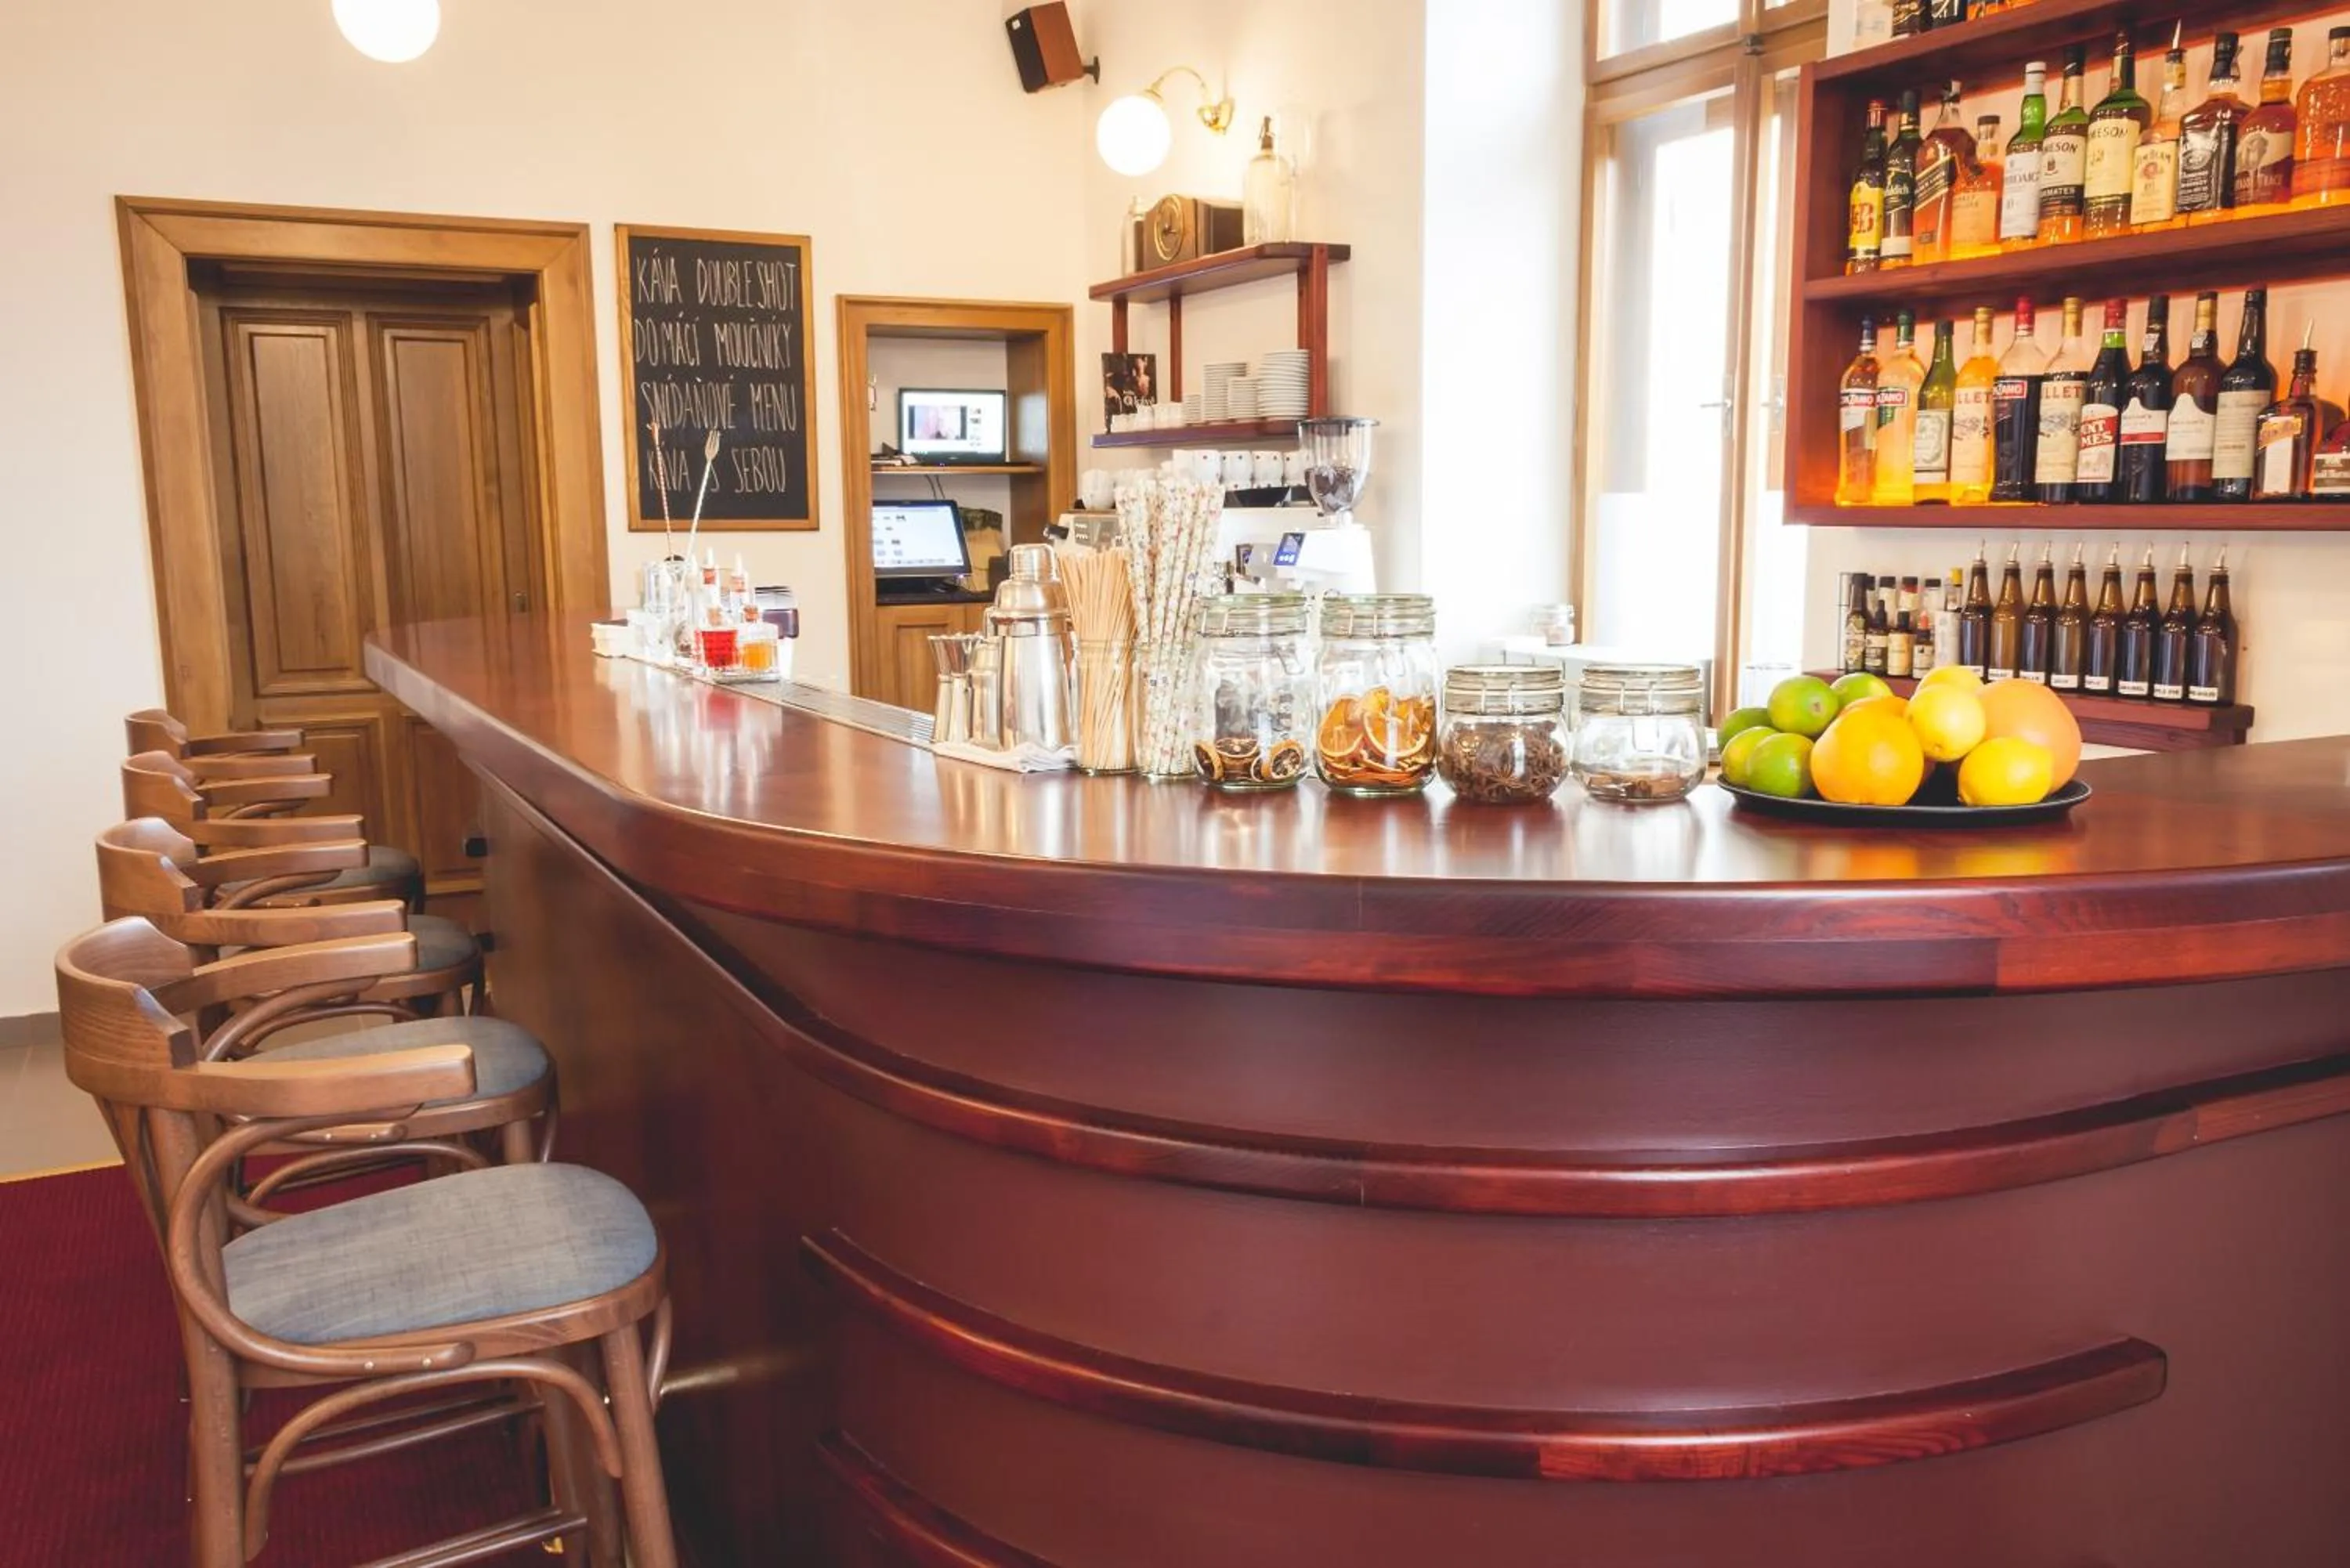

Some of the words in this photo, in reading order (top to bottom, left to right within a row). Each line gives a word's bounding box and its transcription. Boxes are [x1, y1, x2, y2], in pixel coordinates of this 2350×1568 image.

[636, 247, 682, 305] KÁVA
[634, 311, 700, 367] DOMÁCÍ
[750, 382, 797, 432] MENU
[731, 446, 786, 493] SEBOU
